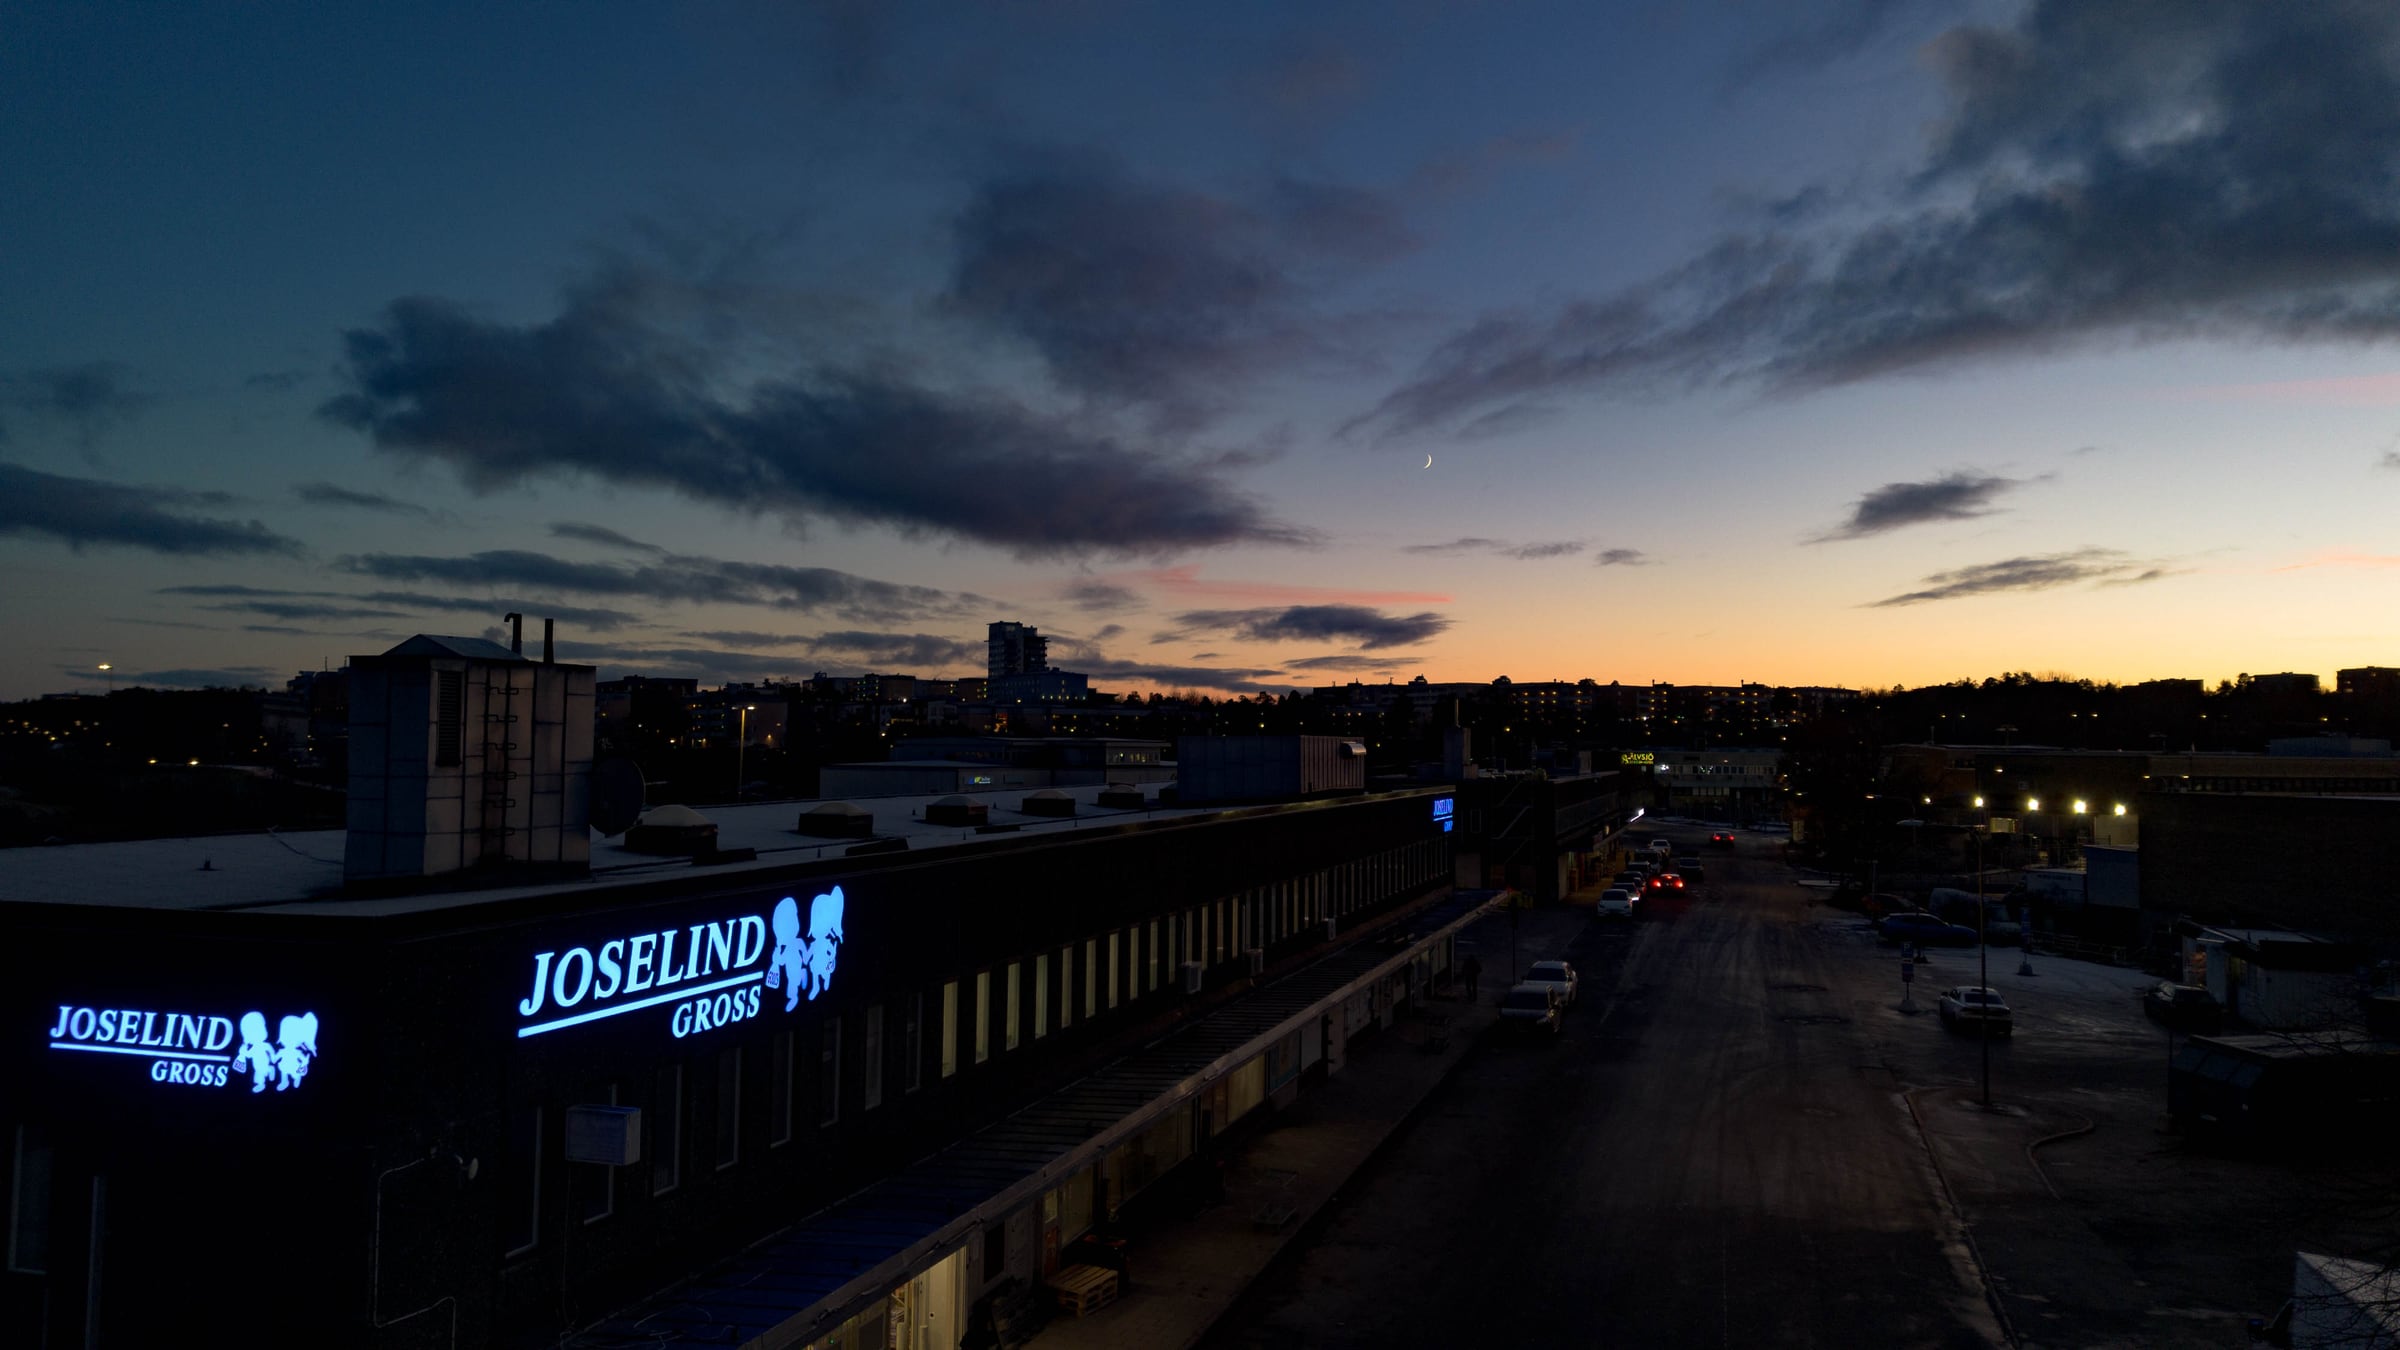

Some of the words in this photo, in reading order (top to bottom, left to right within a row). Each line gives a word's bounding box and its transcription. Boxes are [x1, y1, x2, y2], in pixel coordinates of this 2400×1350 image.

[519, 915, 766, 1016] JOSELIND
[50, 1005, 233, 1051] JOSELIND
[672, 984, 761, 1038] GROSS
[151, 1060, 229, 1087] GROSS
